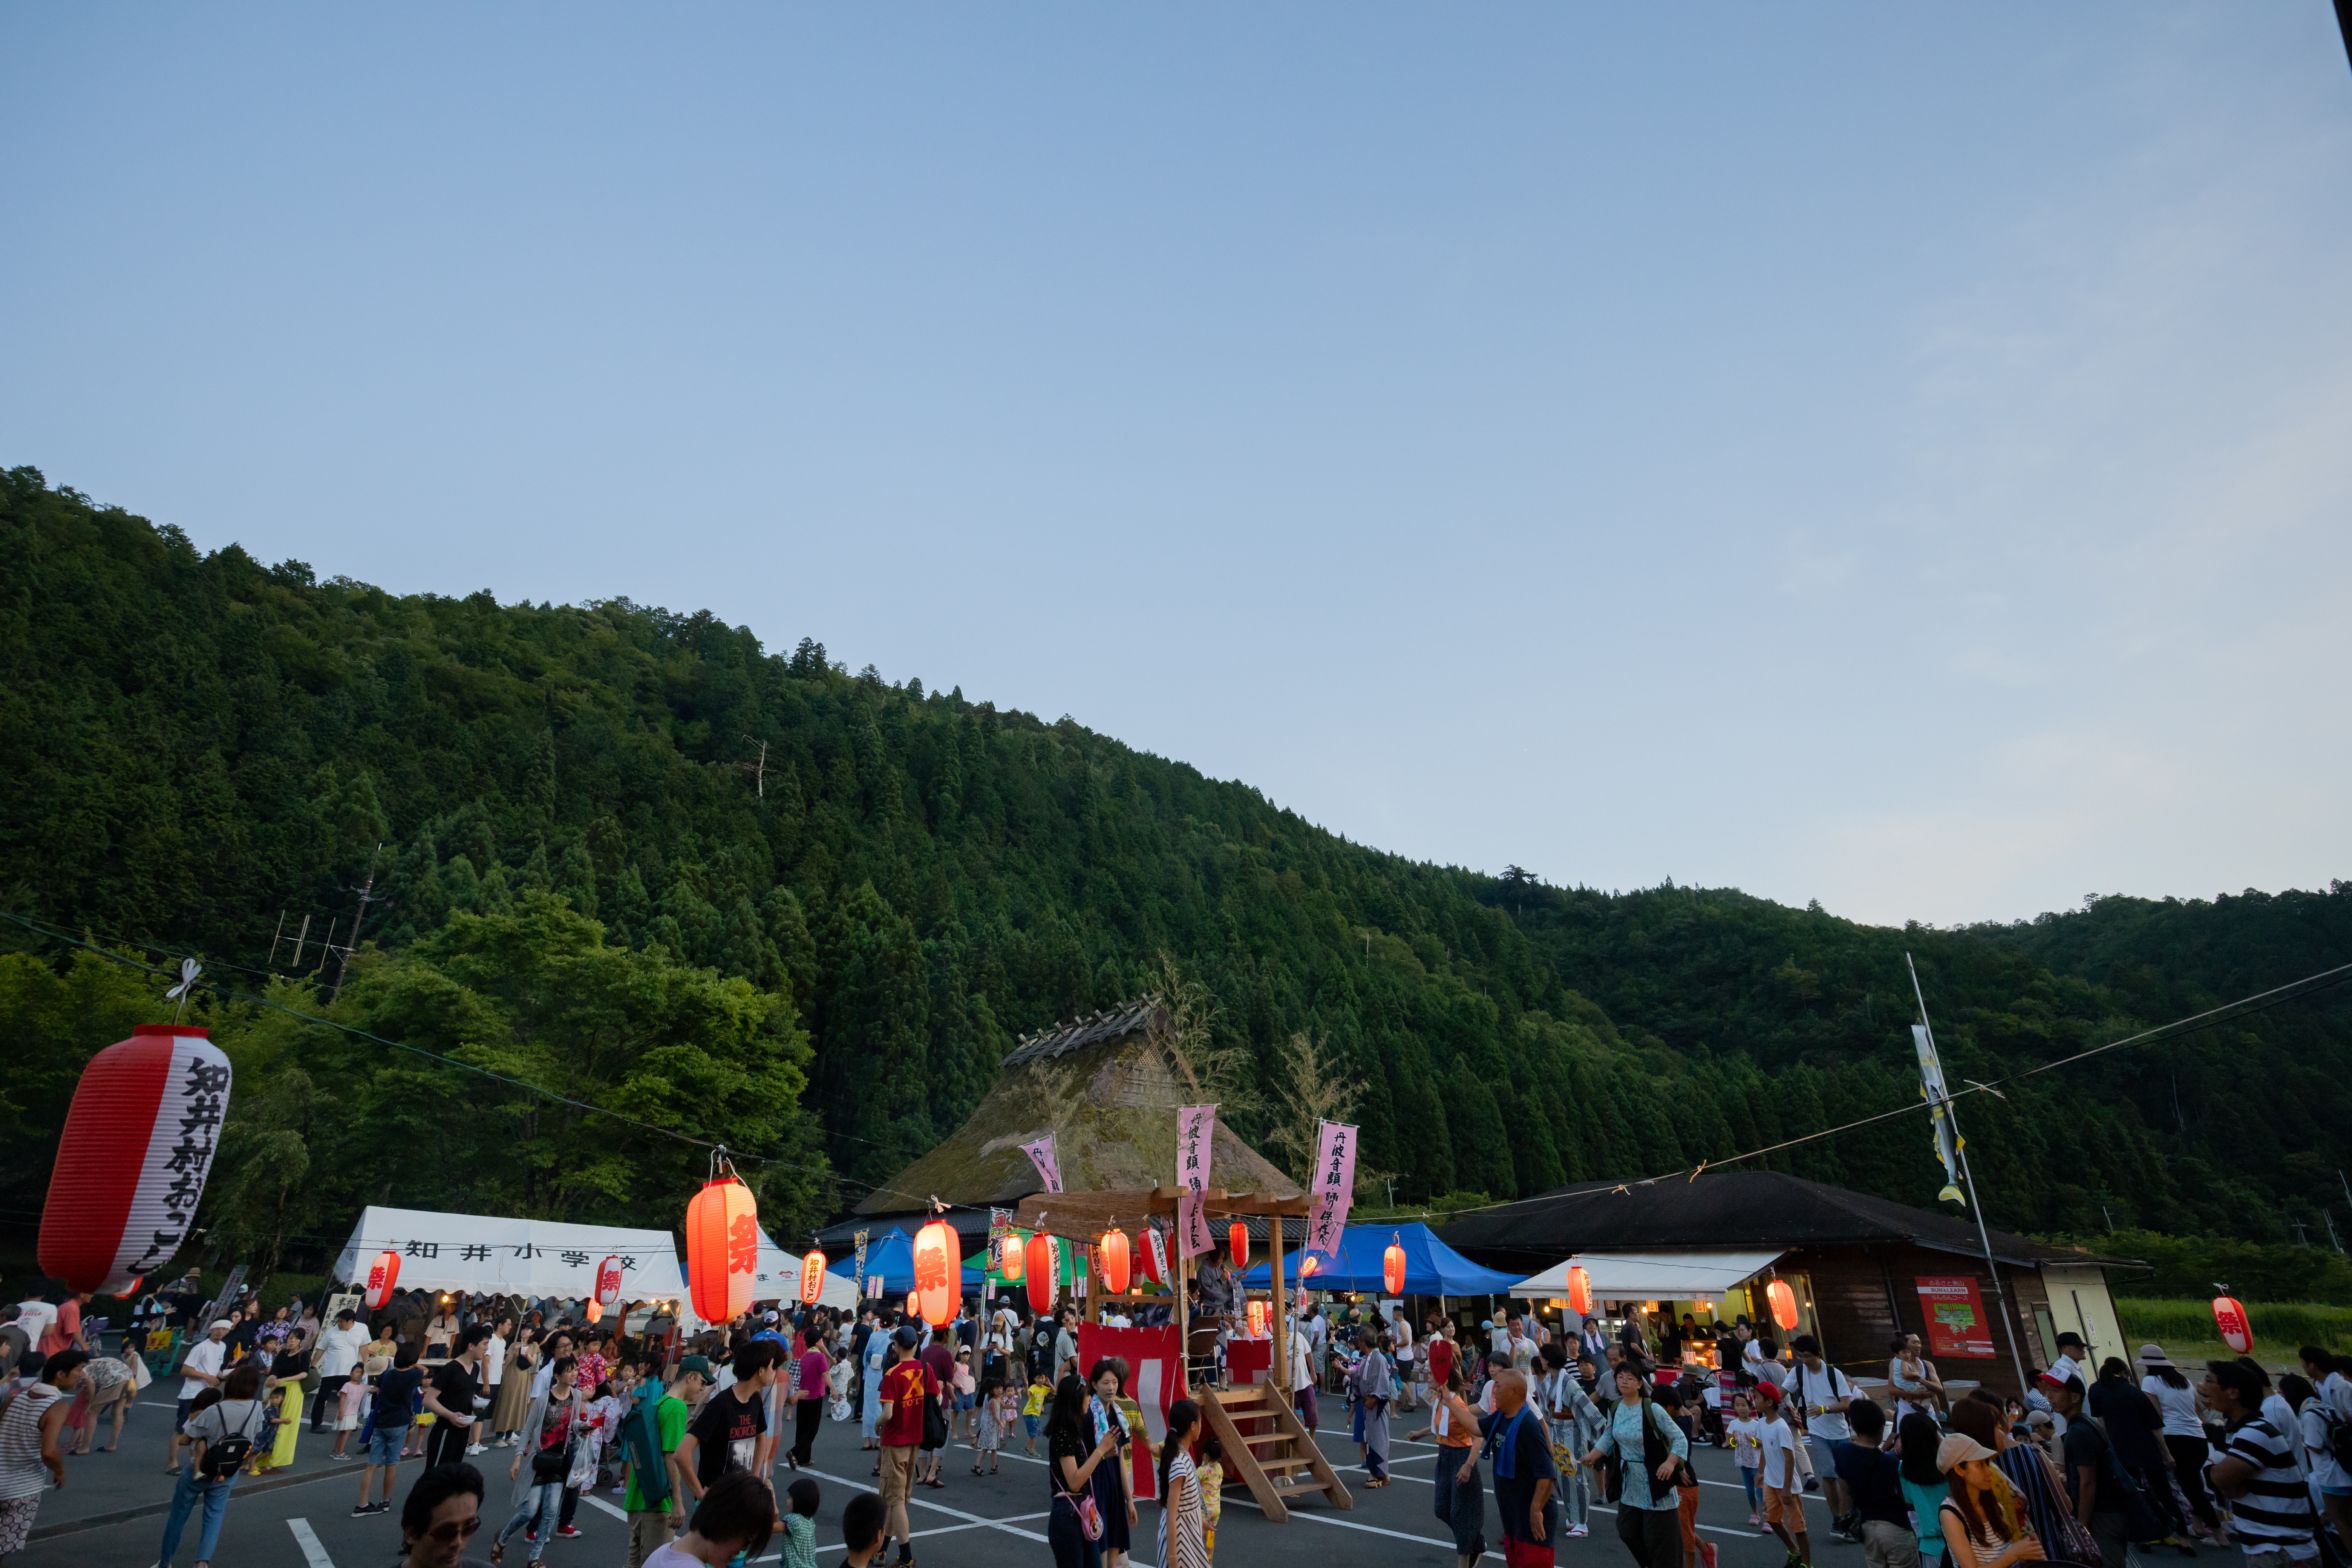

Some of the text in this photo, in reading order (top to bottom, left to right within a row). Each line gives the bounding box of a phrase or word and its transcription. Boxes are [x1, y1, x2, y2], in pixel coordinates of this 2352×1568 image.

[126, 1057, 230, 1274] 知井村おこし
[729, 1213, 757, 1274] 祭
[1008, 1250, 1021, 1268] 祭
[1091, 1244, 1101, 1276] 井村おこし
[1133, 1256, 1145, 1275] 祭
[1153, 1234, 1168, 1280] 知井村おこし
[1384, 1257, 1395, 1278] 祭
[367, 1265, 386, 1290] 祭
[805, 1258, 819, 1301] 知井村おこし
[916, 1246, 947, 1292] 祭
[602, 1270, 620, 1291] 祭
[345, 1298, 358, 1309] 福
[909, 1298, 917, 1308] 祭
[2218, 1310, 2242, 1335] 祭
[901, 1397, 924, 1408] TOT
[738, 1414, 752, 1426] THE
[729, 1424, 757, 1439] EXORCIST
